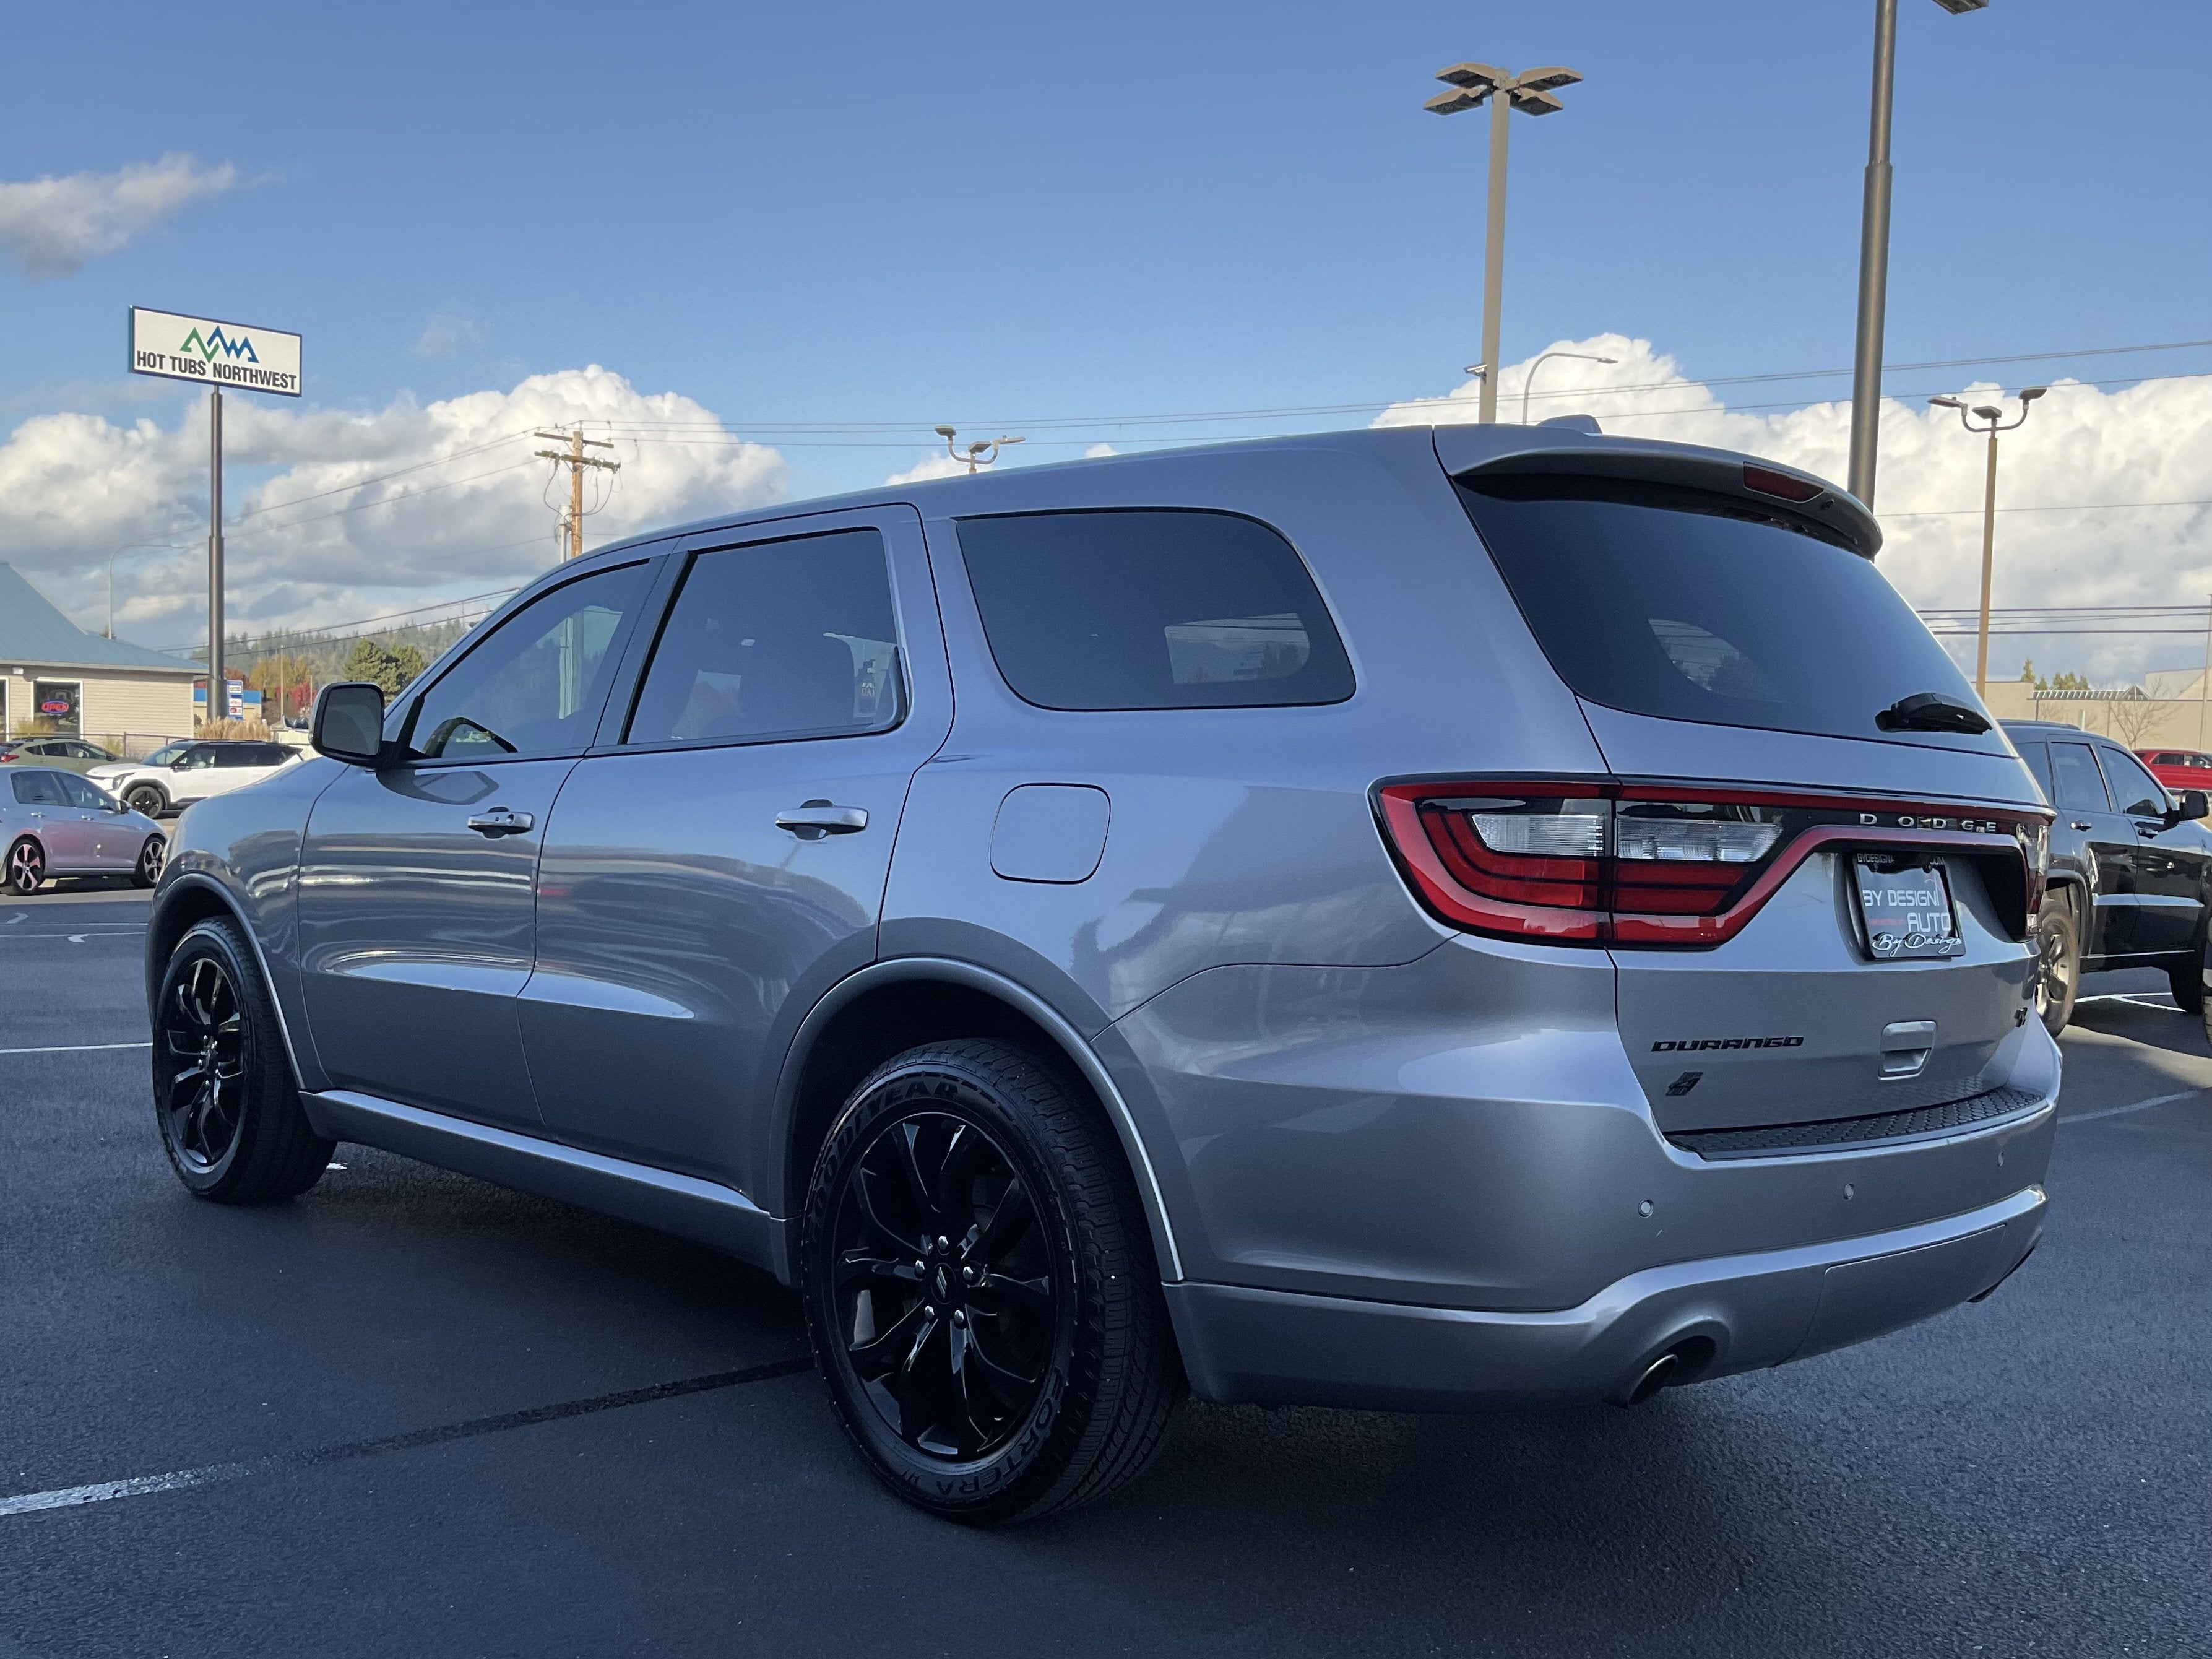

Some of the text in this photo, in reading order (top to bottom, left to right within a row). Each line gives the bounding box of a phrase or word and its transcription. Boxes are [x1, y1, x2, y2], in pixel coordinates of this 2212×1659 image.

[137, 351, 297, 390] HOT TUBS NORTHWEST
[41, 703, 69, 712] OPEN
[1860, 813, 1997, 833] DODGE
[1862, 890, 1940, 907] BY DESIGN
[1907, 912, 1951, 932] AUTO
[1872, 932, 1963, 958] By Design
[1651, 1036, 1804, 1052] DURANGO
